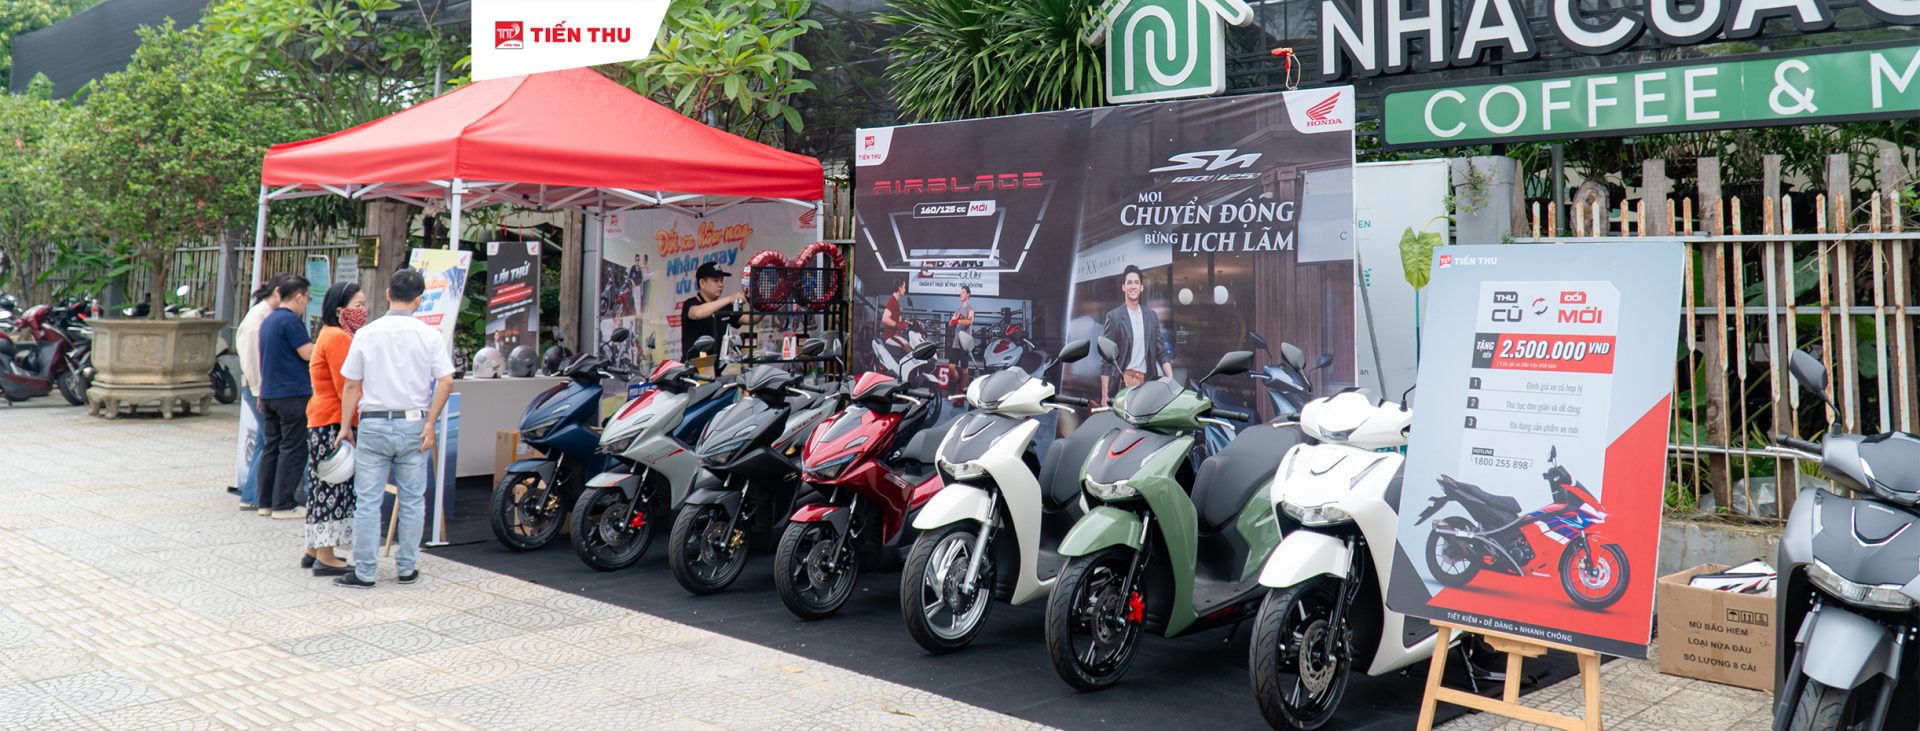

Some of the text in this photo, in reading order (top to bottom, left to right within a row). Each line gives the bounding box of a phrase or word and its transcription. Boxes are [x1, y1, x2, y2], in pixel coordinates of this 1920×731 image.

[1424, 67, 1720, 138] COFFEE
[1769, 59, 1818, 116] &
[1306, 118, 1343, 127] HONDA
[873, 171, 1043, 196] AIRBLADE
[1138, 191, 1162, 205] MỌI
[921, 205, 956, 214] 160/125
[1120, 196, 1295, 228] CHUYỂN ĐỘNG
[680, 234, 695, 252] xe
[723, 223, 753, 251] nay
[1144, 226, 1295, 257] BỪNG LỊCH LÃM
[666, 254, 699, 277] Nhận
[1454, 254, 1497, 265] TIẾN THU
[493, 268, 509, 285] LÁI
[1496, 294, 1516, 302] THU
[1491, 306, 1523, 323] CŨ
[1558, 306, 1602, 324] MỚI
[1499, 339, 1610, 361] 2.500.000 VND
[939, 367, 949, 386] 5
[1474, 379, 1478, 387] 1
[1470, 398, 1476, 407] 2
[1468, 418, 1473, 426] 3
[1474, 457, 1528, 470] 1800 255 898
[1447, 611, 1461, 620] TIẾT
[1461, 615, 1478, 624] KIỆM
[1494, 621, 1513, 631] DÀNG
[1519, 626, 1545, 636] NHANH
[1546, 631, 1573, 642] CHÓNG
[1688, 637, 1708, 648] LOẠI
